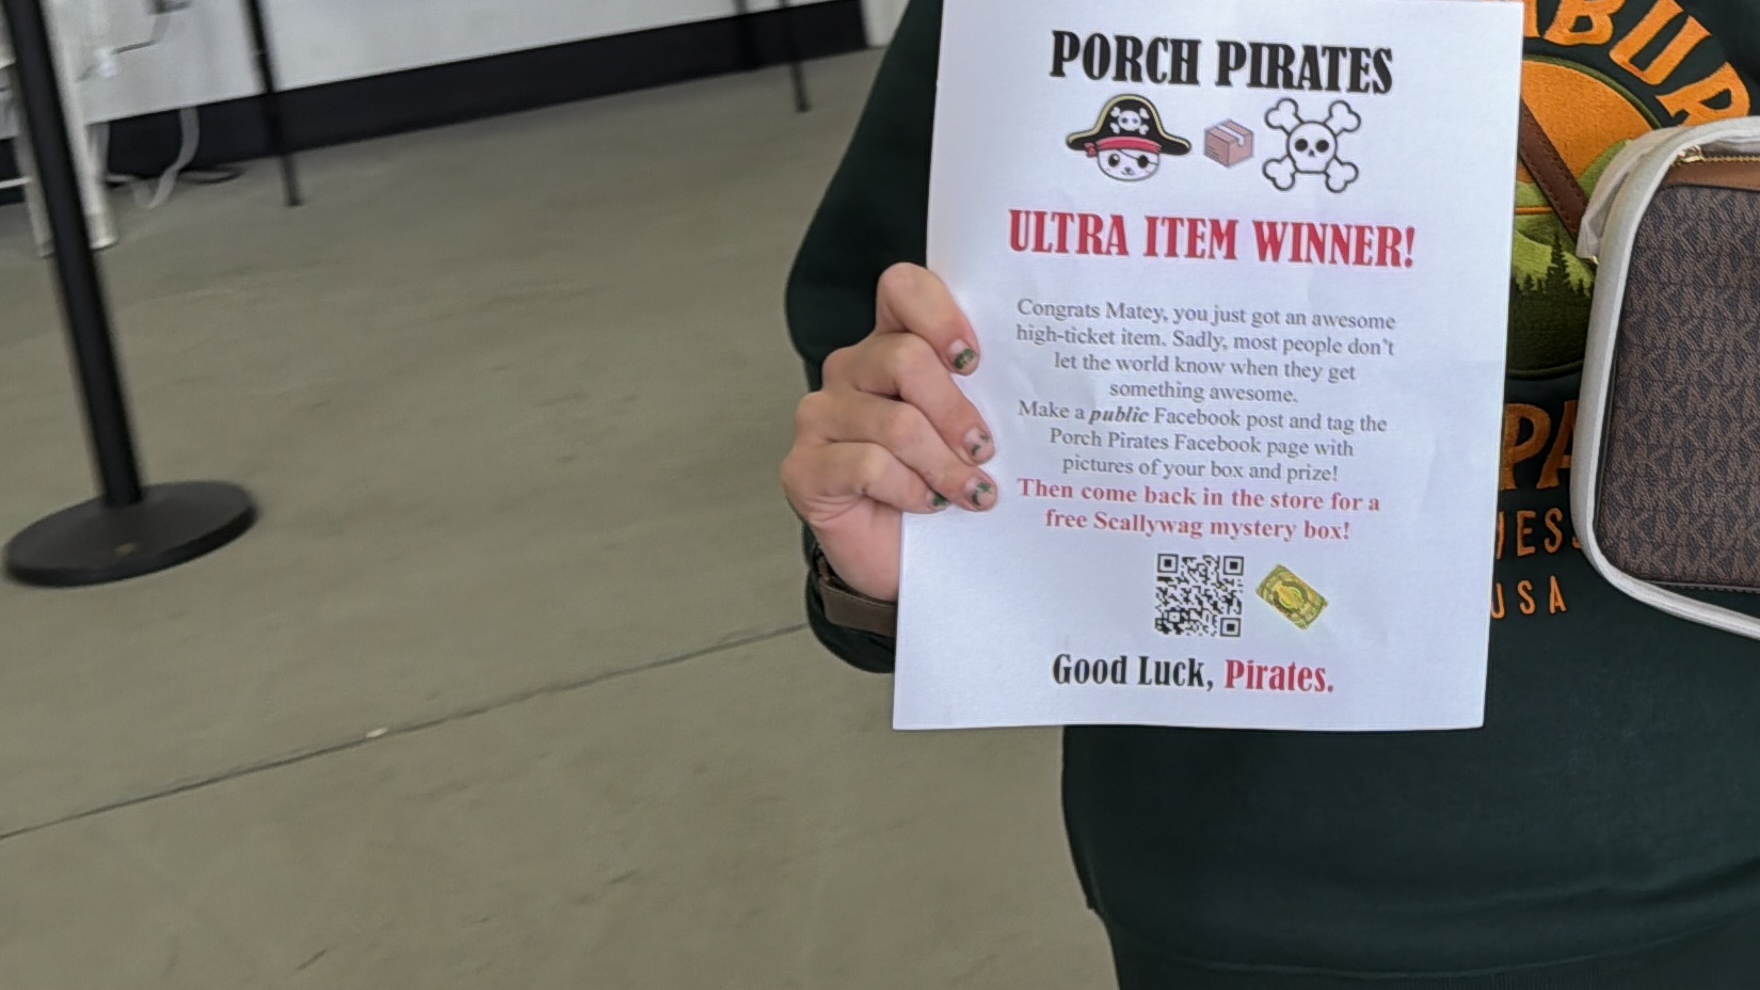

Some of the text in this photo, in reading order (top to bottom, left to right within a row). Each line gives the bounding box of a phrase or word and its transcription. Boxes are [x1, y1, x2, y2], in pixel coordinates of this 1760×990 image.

[1049, 30, 1393, 95] PORCH PIRATES
[1009, 209, 1415, 268] ULTRA ITEM WINNER!
[1017, 298, 1395, 330] Congrats Matey, you just got an awesome
[1017, 324, 1115, 345] high-ticket
[1122, 328, 1167, 347] item.
[1173, 330, 1227, 352] Sadly,
[1234, 337, 1277, 350] most
[1283, 336, 1342, 357] people
[1055, 352, 1355, 384] let the world know when they get
[1110, 381, 1297, 403] something awesome.
[1020, 400, 1387, 435] Make a public Facebook post and tag the
[1051, 428, 1353, 458] Porch Pirates Facebook page with
[1063, 454, 1337, 484] pictures of your box and prize!
[1017, 478, 1379, 511] Then come back in the store for a
[1046, 509, 1349, 542] free Scallywag mystery box!
[1053, 654, 1333, 693] Good Luck, Pirates.
